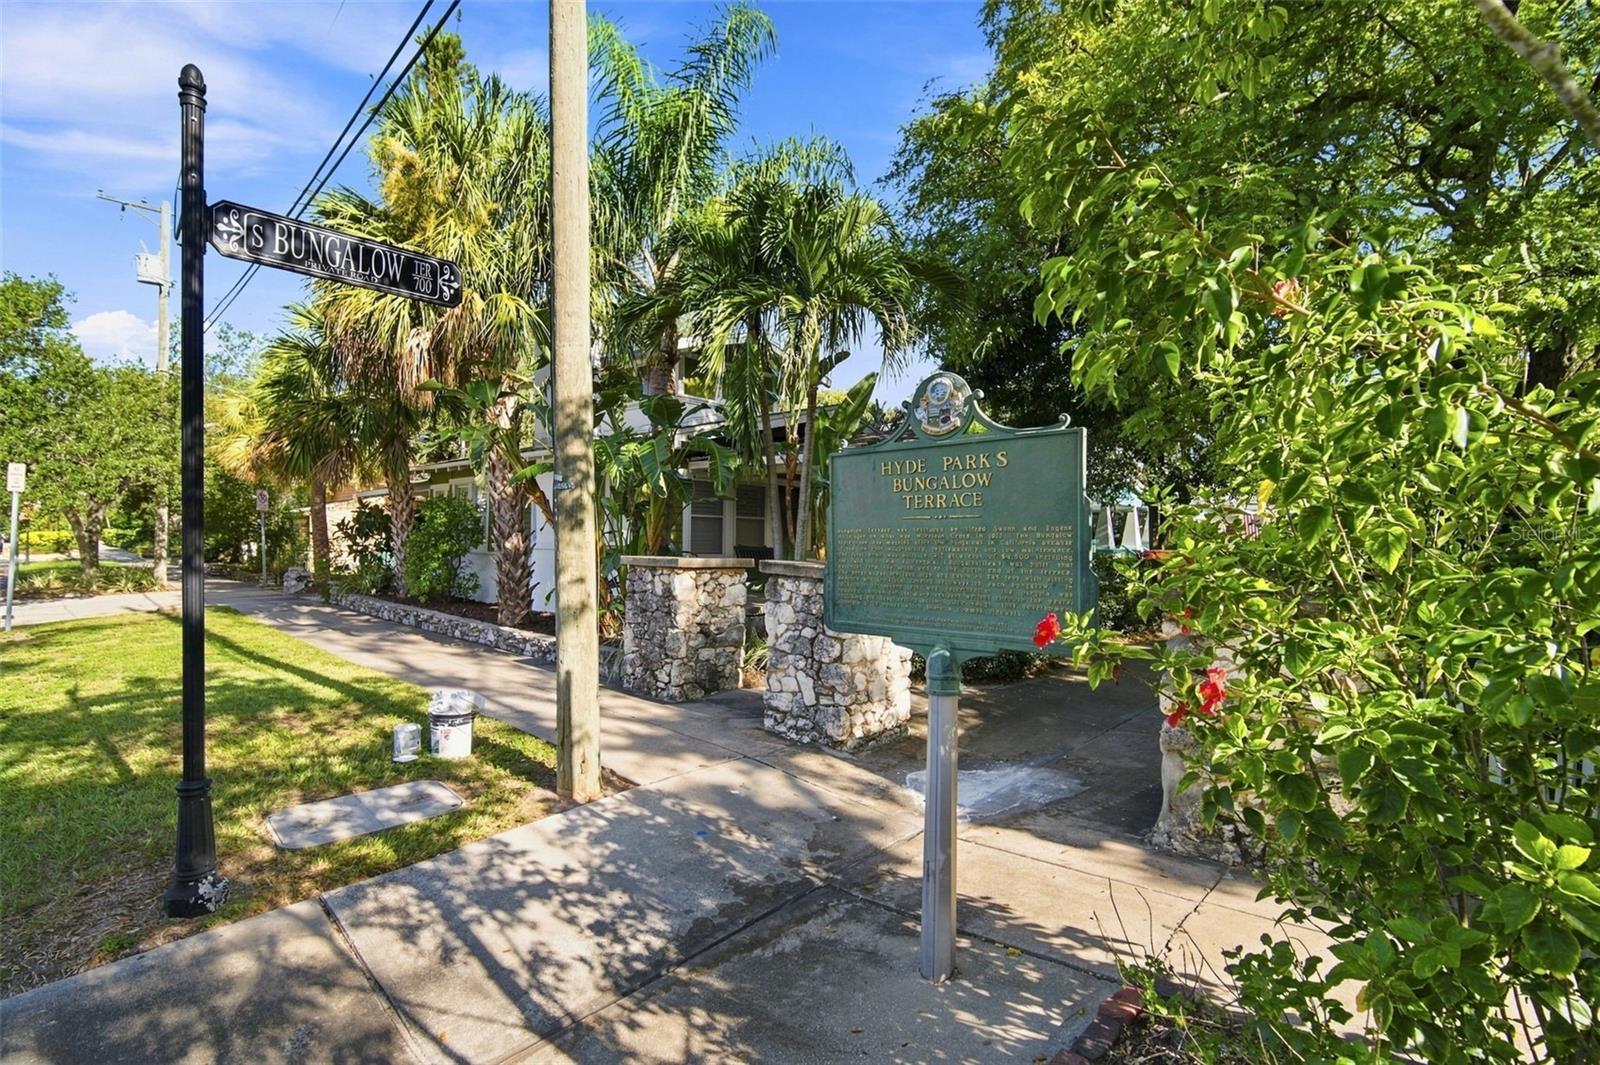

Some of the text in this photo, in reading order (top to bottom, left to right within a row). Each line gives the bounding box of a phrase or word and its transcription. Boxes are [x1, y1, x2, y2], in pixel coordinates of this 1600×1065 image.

[251, 223, 404, 282] S BUNGALOW
[304, 260, 379, 283] PRIVATE ROAD
[413, 260, 432, 278] TER
[413, 277, 432, 294] 700
[882, 459, 926, 475] HYDE
[893, 473, 992, 492] BUNGALOW
[904, 493, 983, 509] TERRACE
